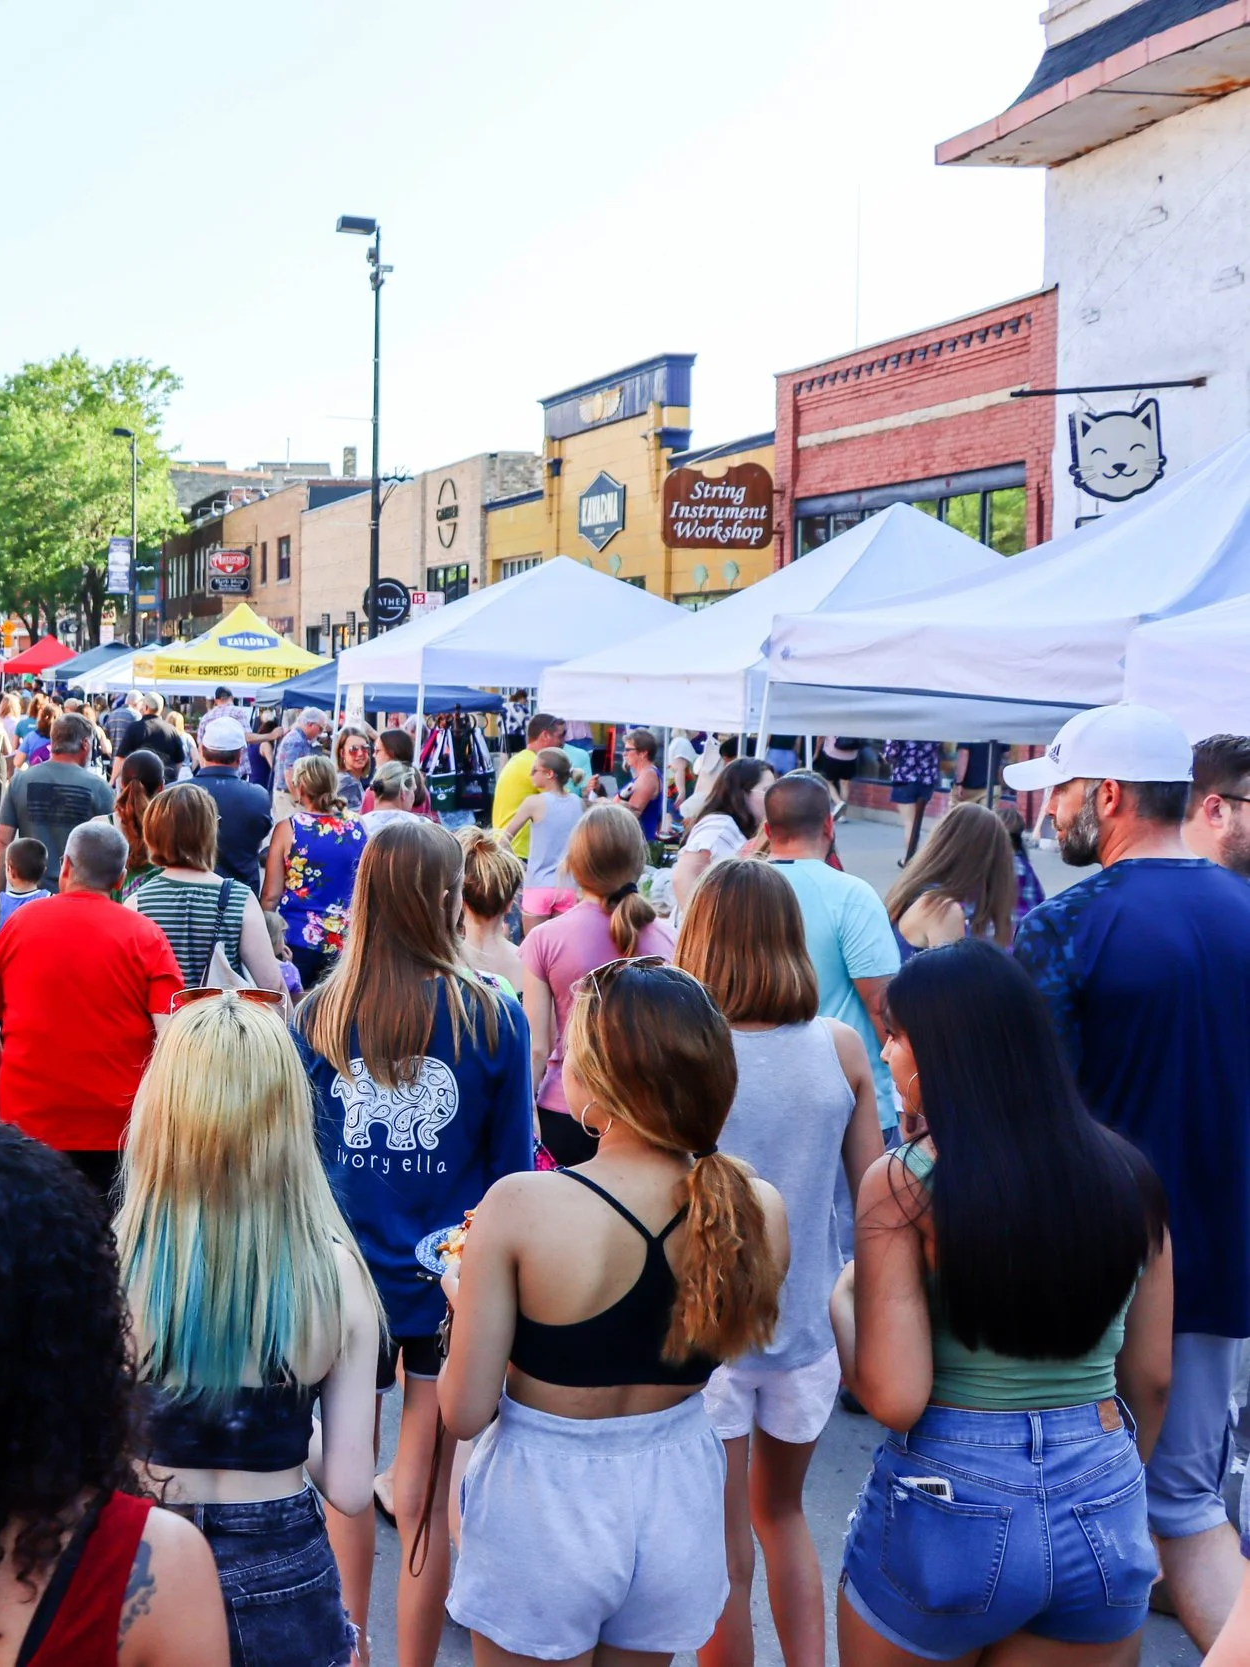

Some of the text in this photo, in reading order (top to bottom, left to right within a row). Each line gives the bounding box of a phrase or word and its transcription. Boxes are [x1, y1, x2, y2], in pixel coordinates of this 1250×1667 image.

[690, 481, 747, 505] String
[670, 501, 768, 519] Instrument
[673, 519, 764, 545] Workshop
[376, 598, 408, 606] ATHER
[170, 665, 190, 675] CAFE
[198, 665, 239, 676] ESPRESSO
[246, 667, 276, 678] COFFEE
[337, 1145, 447, 1175] ivory ella
